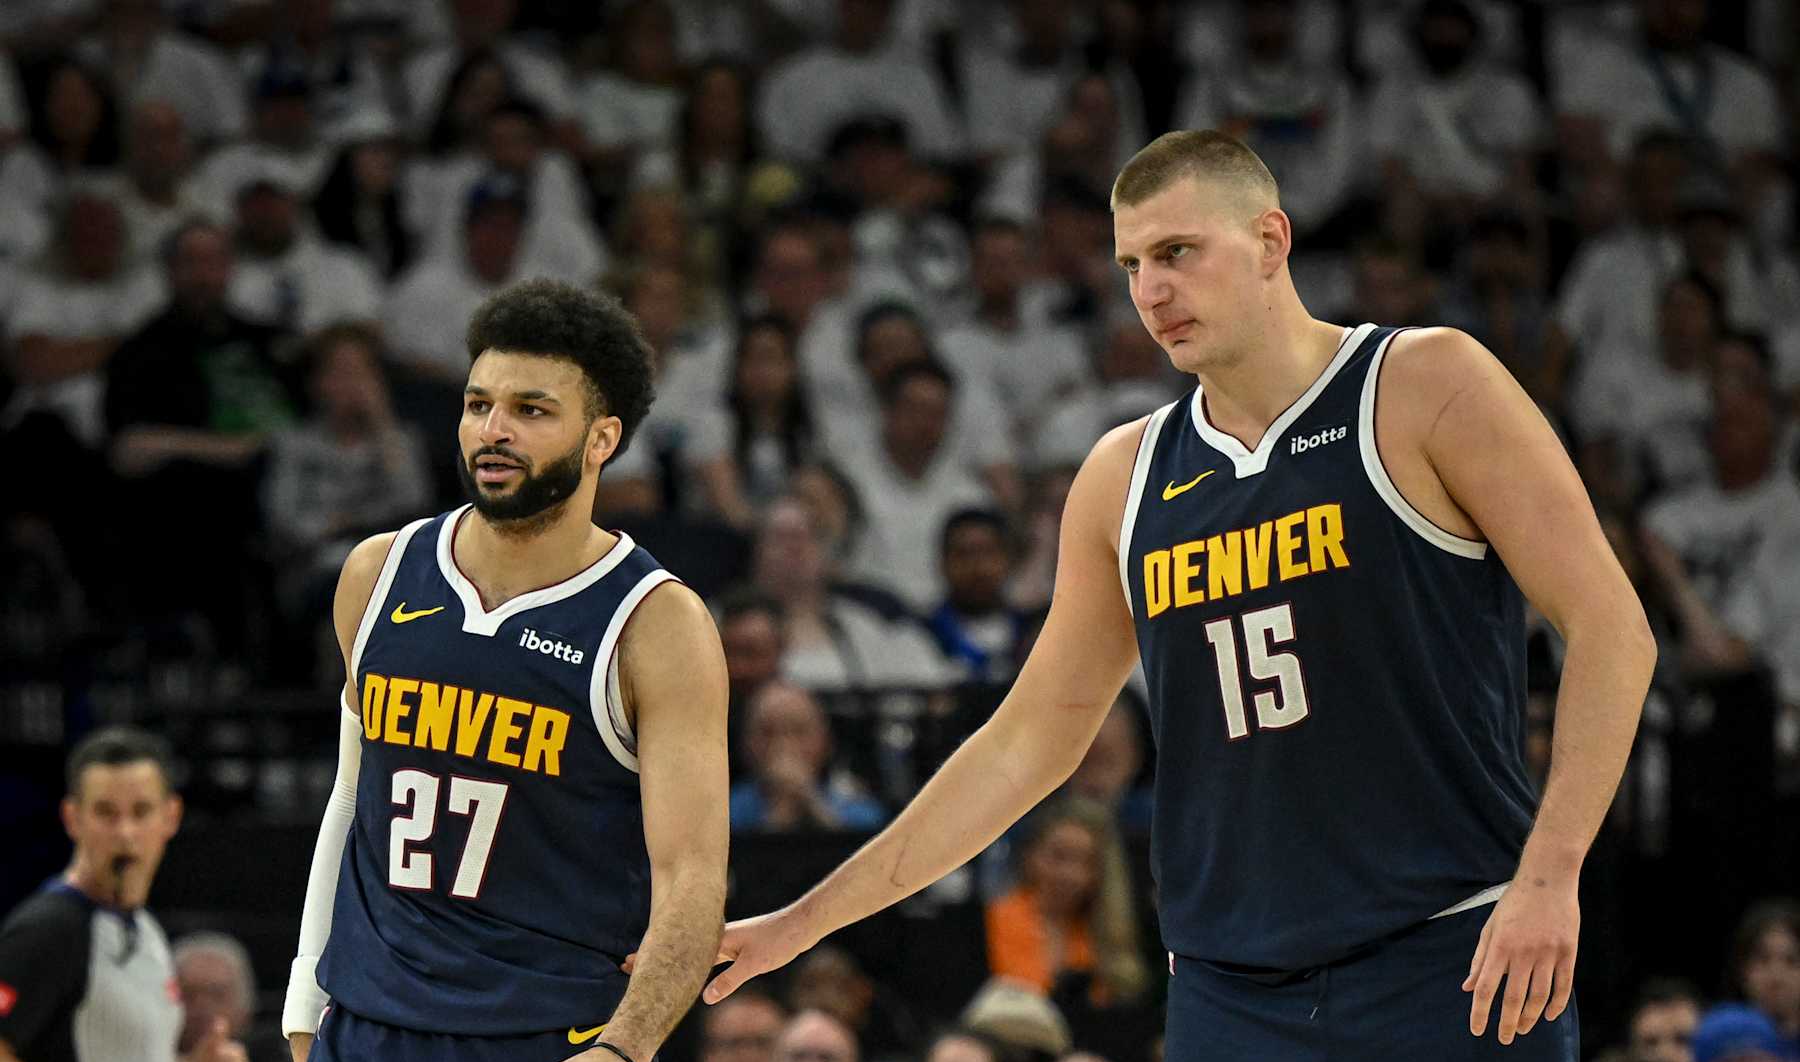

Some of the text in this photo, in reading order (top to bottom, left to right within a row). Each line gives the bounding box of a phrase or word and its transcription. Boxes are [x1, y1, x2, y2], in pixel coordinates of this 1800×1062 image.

[1290, 426, 1347, 455] ibotta
[1143, 503, 1350, 619] DENVER
[519, 628, 584, 665] ibotta
[1203, 601, 1311, 742] 15
[362, 672, 572, 777] DENVER
[388, 767, 511, 900] 27
